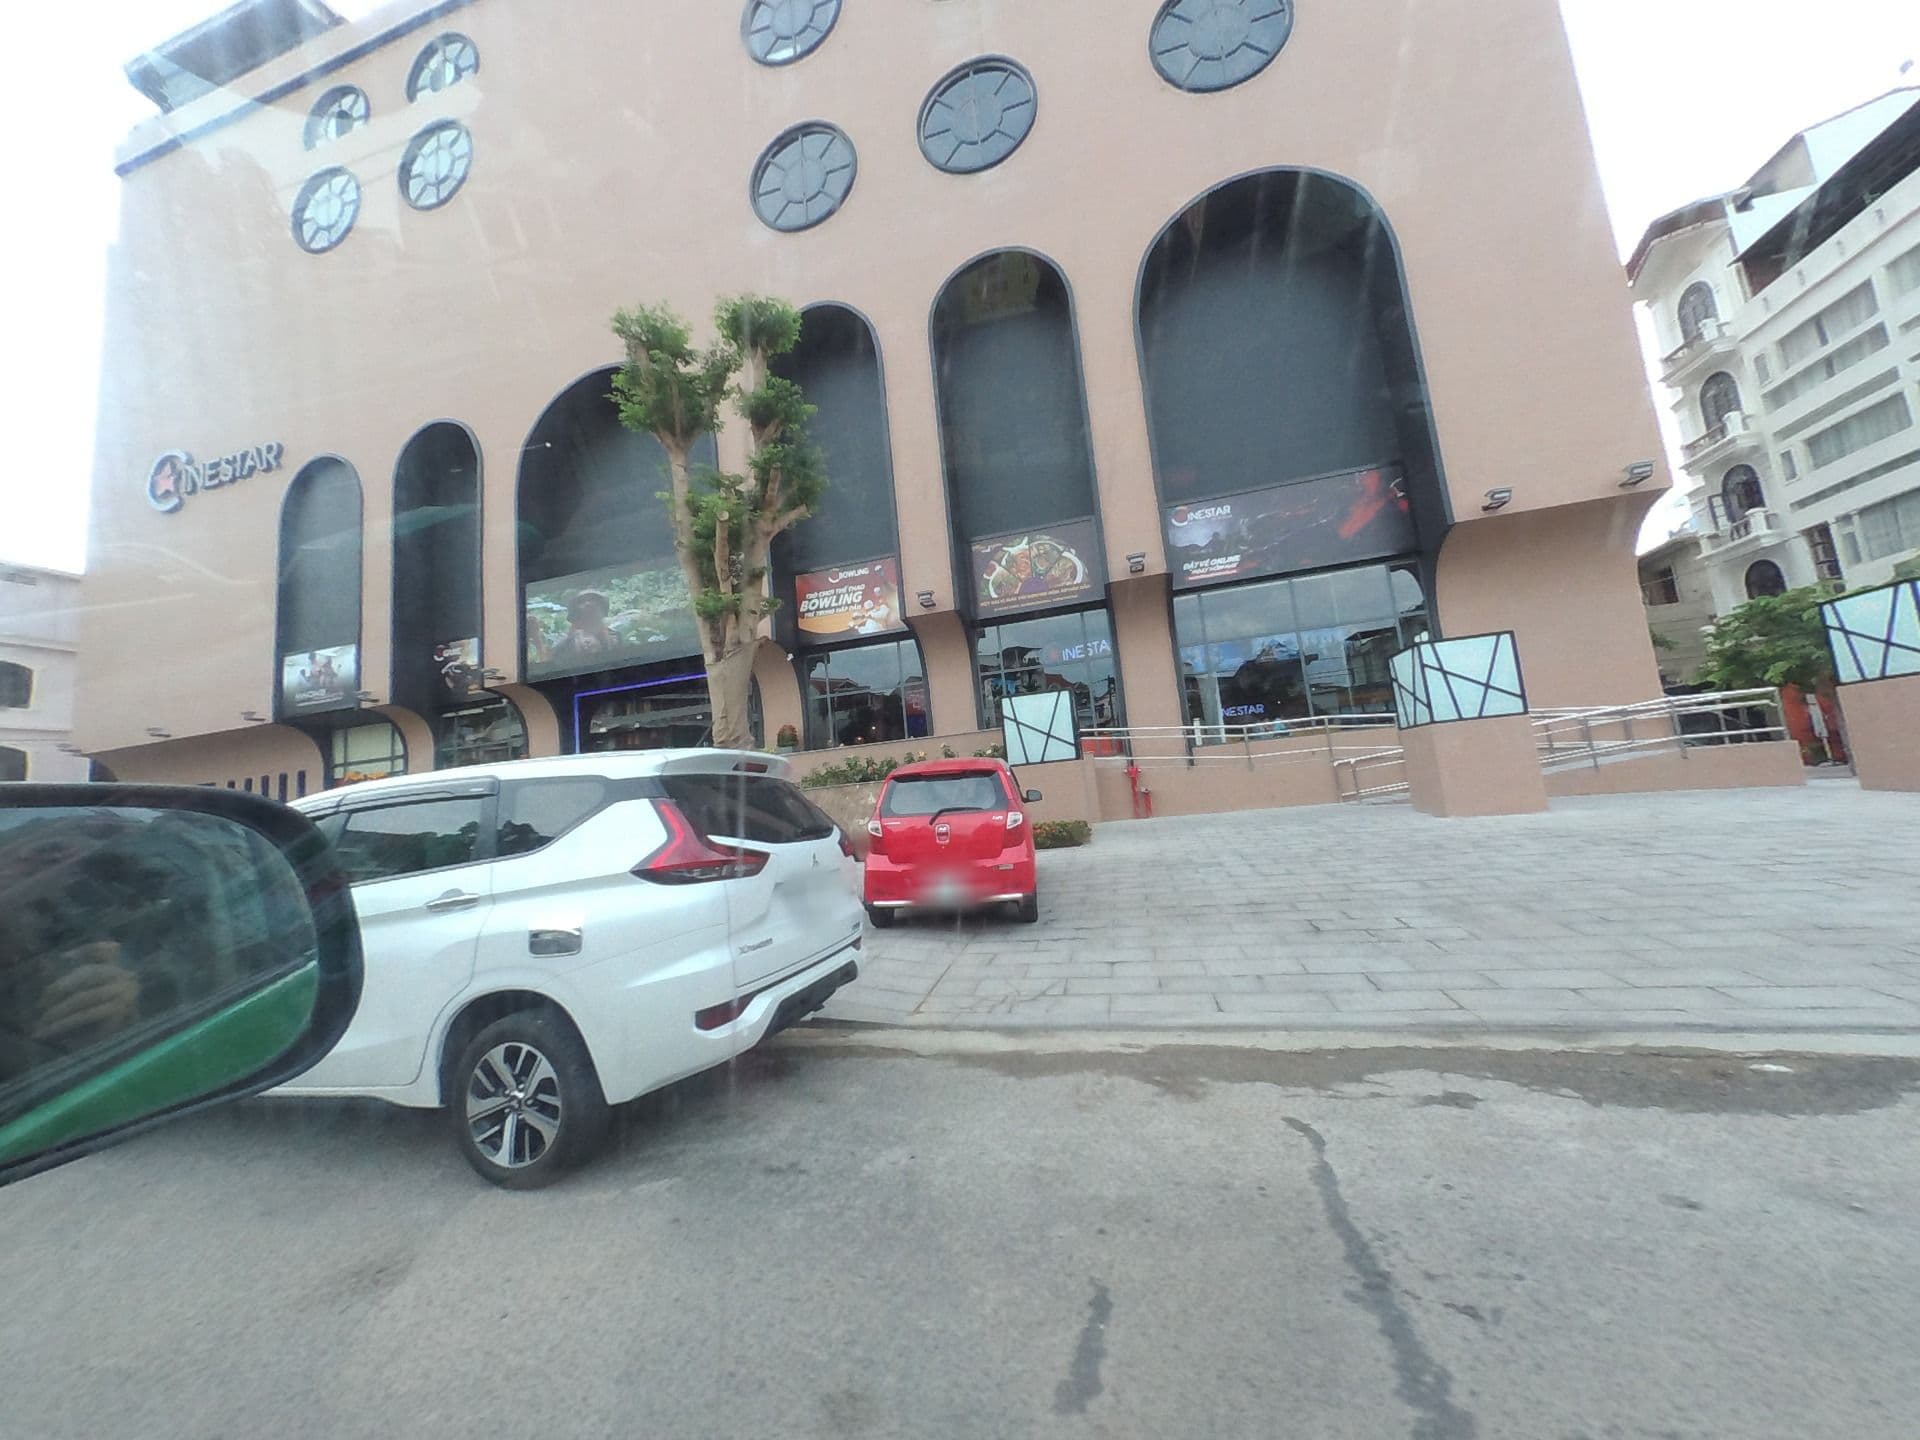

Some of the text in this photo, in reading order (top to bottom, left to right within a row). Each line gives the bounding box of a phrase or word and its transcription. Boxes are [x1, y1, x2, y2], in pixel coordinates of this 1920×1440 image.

[146, 441, 284, 513] CINESTAR
[800, 591, 863, 612] BOWLING
[1062, 640, 1111, 661] INESTA
